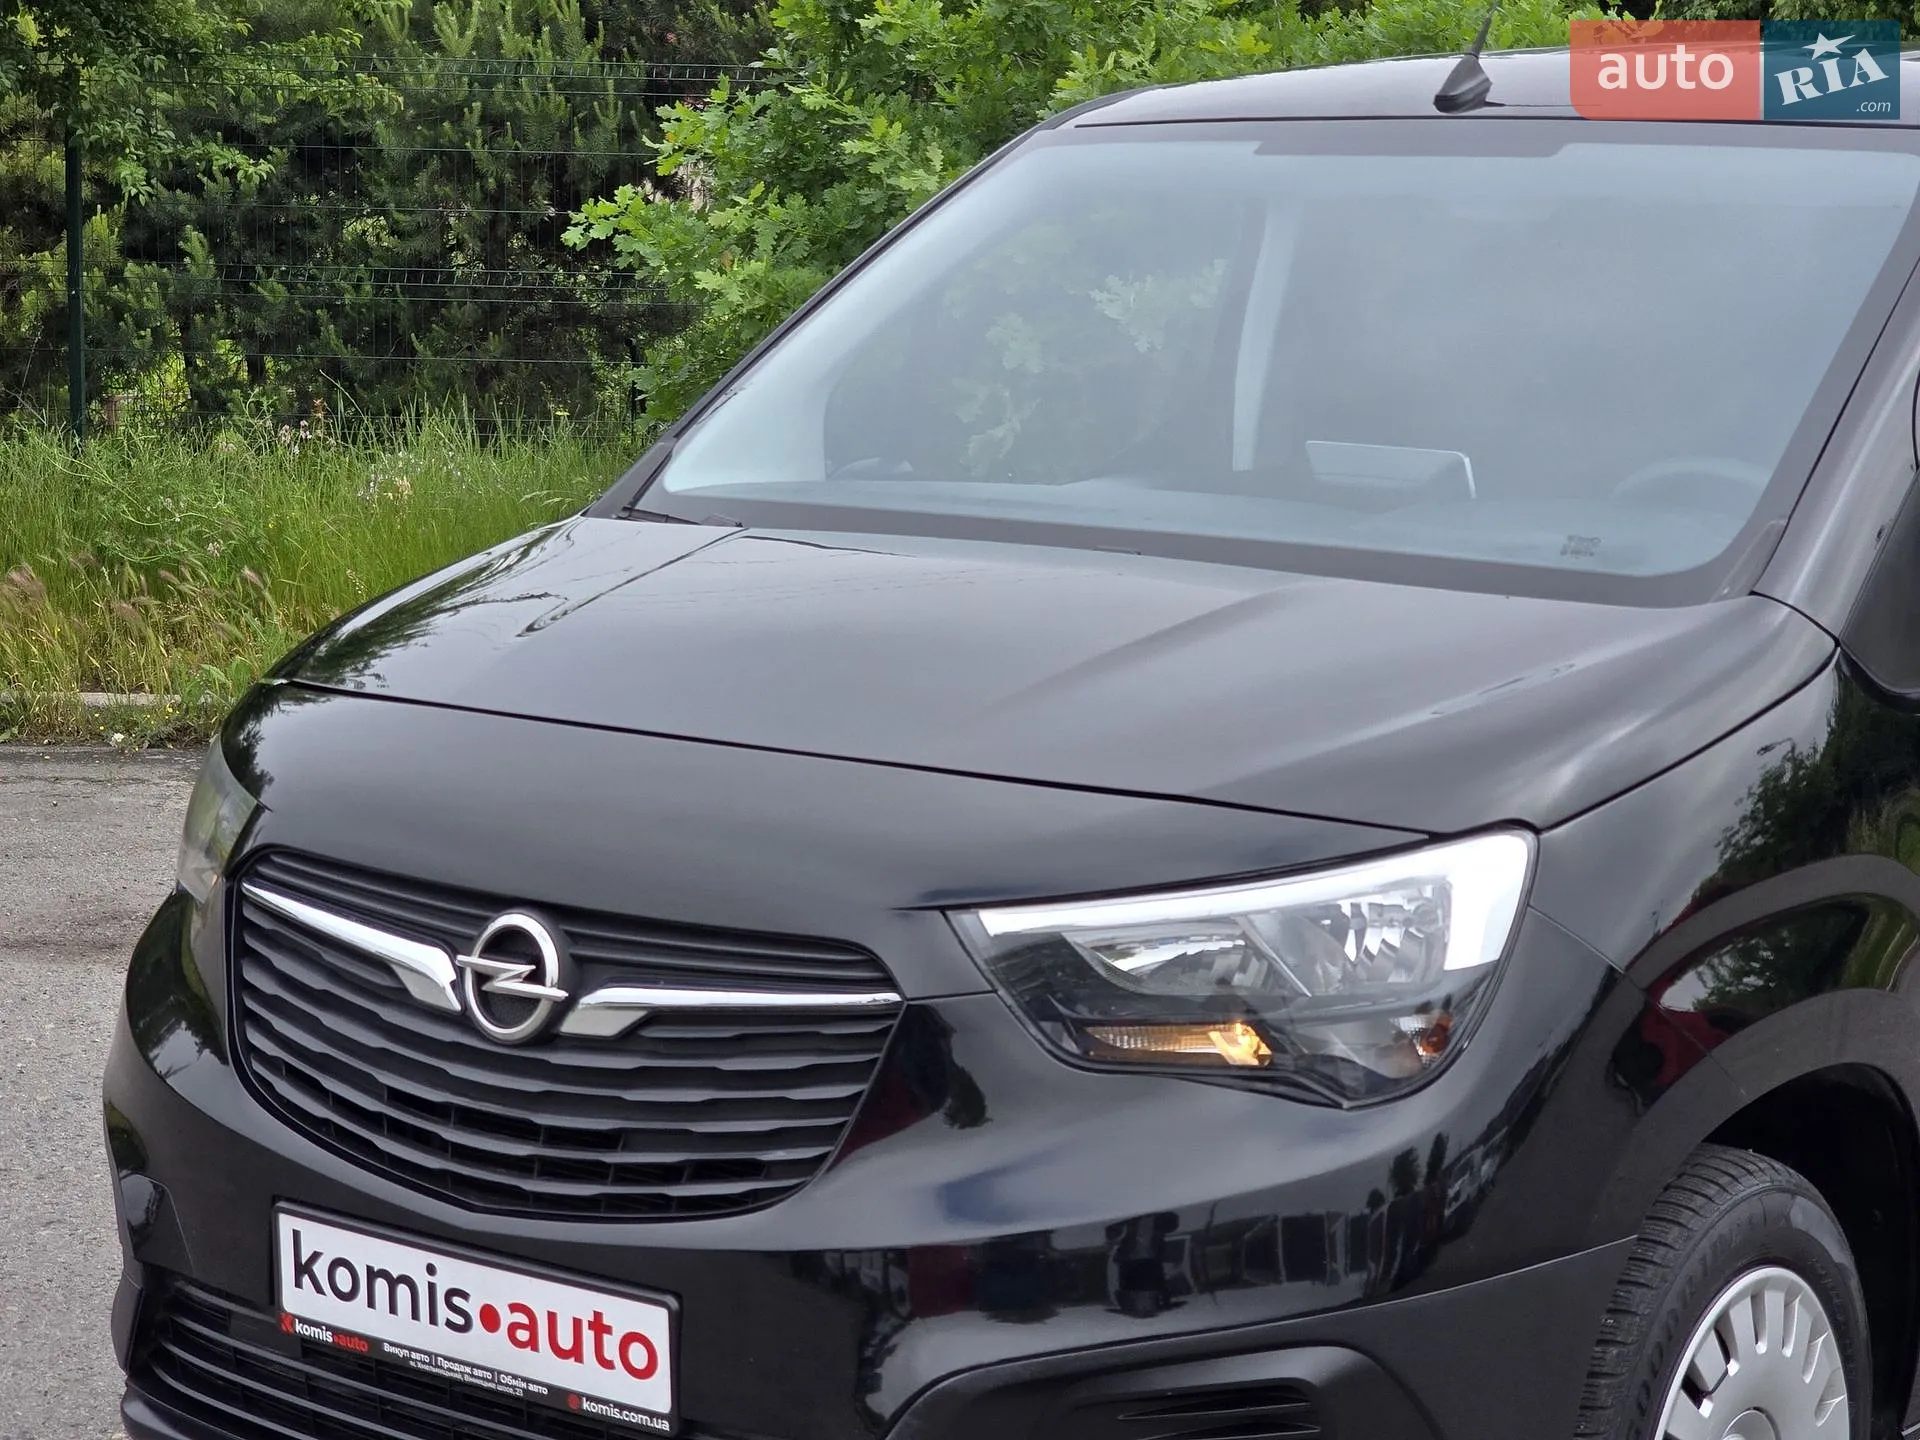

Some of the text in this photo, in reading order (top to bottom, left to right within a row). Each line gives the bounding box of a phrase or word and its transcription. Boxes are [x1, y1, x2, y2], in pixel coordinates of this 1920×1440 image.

[383, 1342, 548, 1395] Викуп авто Продаж авто Обмін авто
[582, 1397, 670, 1432] komis.com.ua
